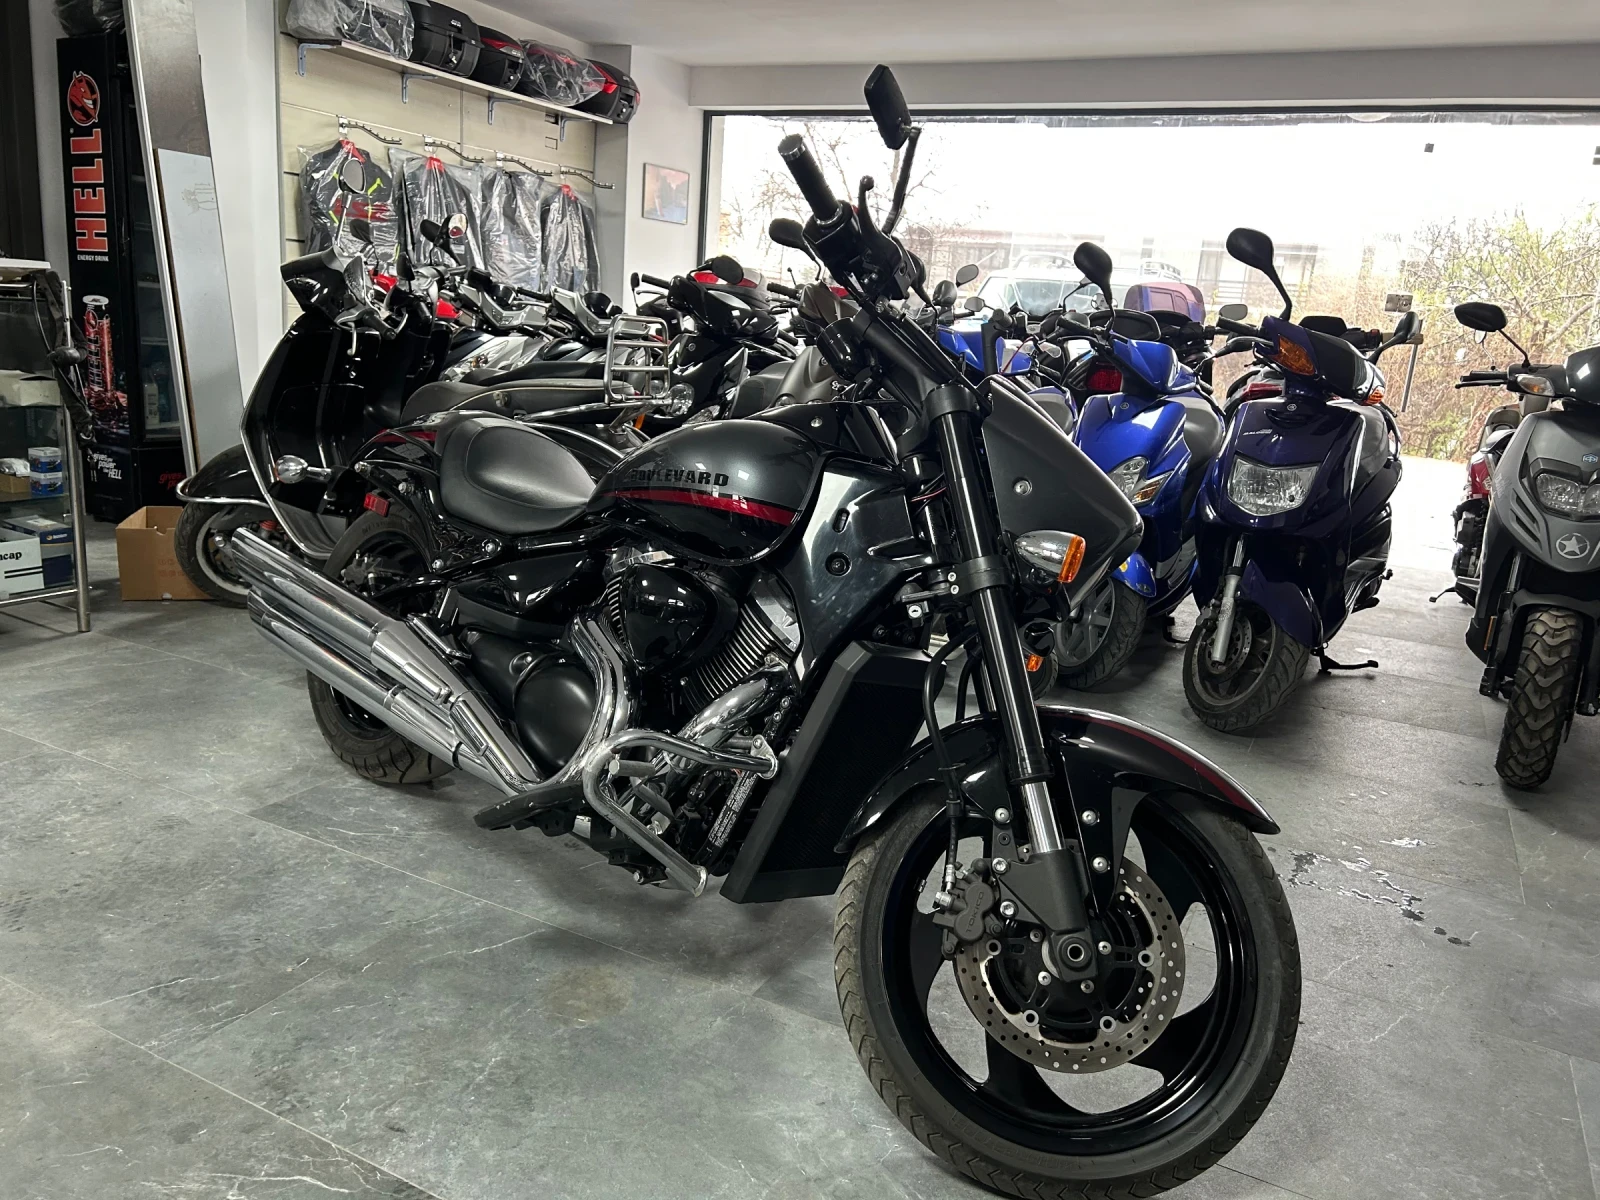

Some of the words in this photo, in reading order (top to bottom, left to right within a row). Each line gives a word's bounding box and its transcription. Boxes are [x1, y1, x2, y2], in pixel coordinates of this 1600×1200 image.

[70, 128, 108, 252] HELL
[98, 460, 116, 469] power
[108, 469, 122, 479] HELL
[631, 468, 729, 487] BOULEVARD
[965, 891, 984, 933] TOKICO
